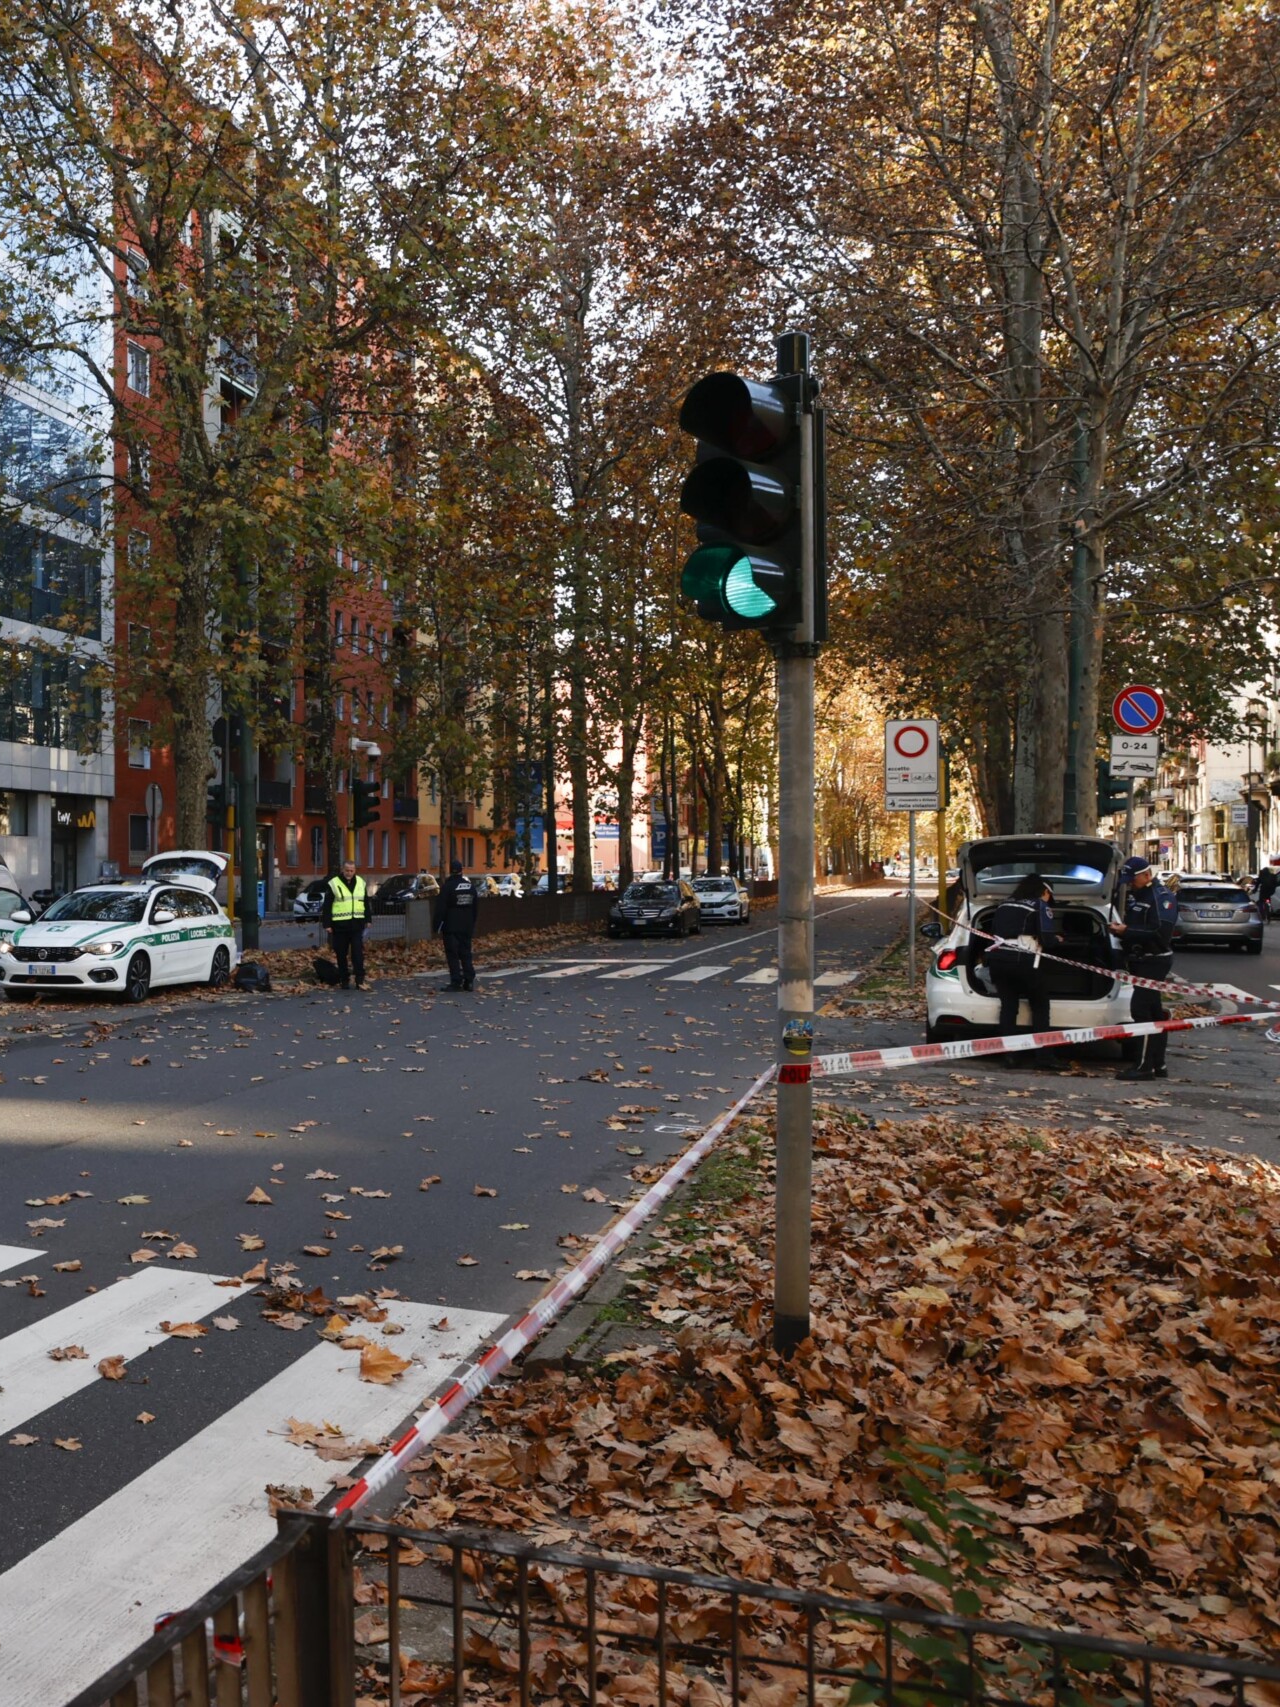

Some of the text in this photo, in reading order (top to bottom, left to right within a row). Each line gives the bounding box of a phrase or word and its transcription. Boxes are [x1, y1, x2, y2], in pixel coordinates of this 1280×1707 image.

[1121, 742, 1148, 750] 0-24
[161, 929, 207, 943] POLIZIA LOCALE
